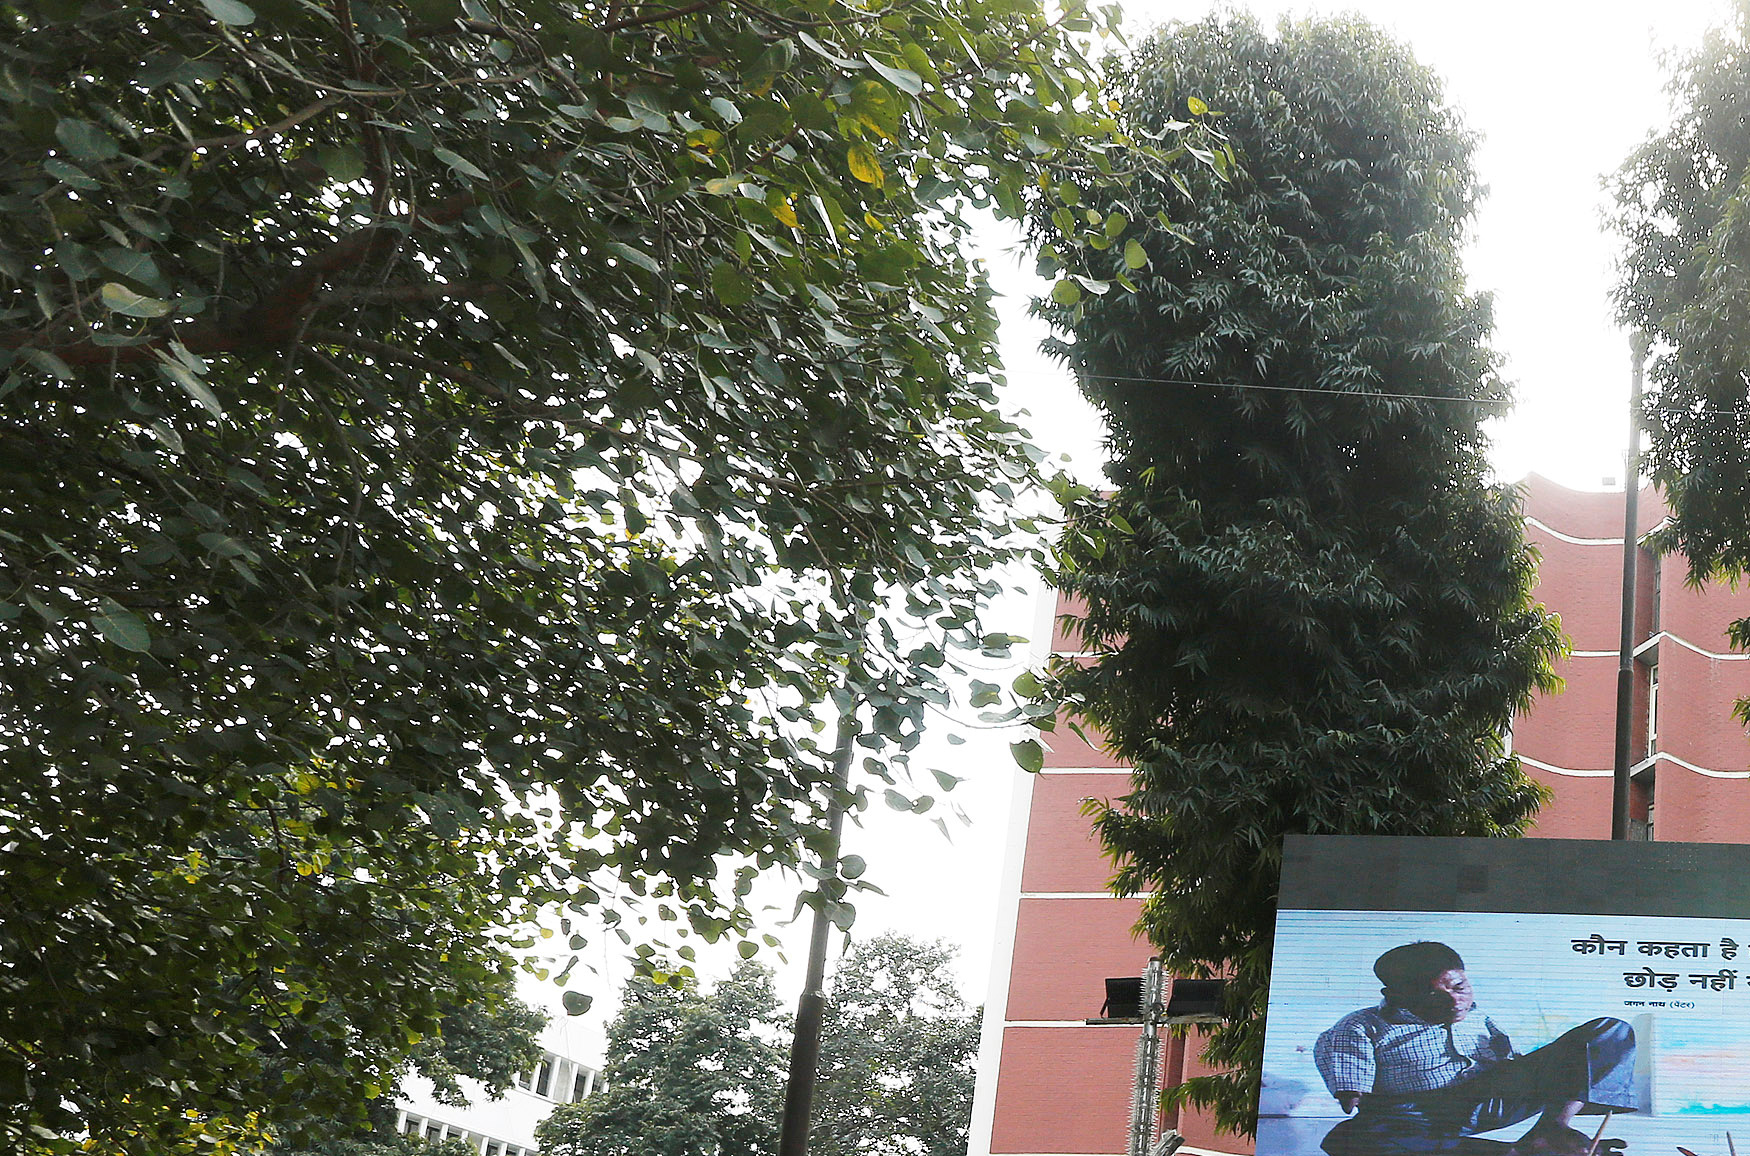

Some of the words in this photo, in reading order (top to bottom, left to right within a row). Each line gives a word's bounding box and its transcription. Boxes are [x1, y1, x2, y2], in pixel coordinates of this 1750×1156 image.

[1571, 934, 1628, 955] कौन
[1637, 941, 1710, 958] कहता
[1720, 938, 1739, 960] है
[1623, 967, 1679, 992] छोड़
[1689, 969, 1738, 991] नहीं
